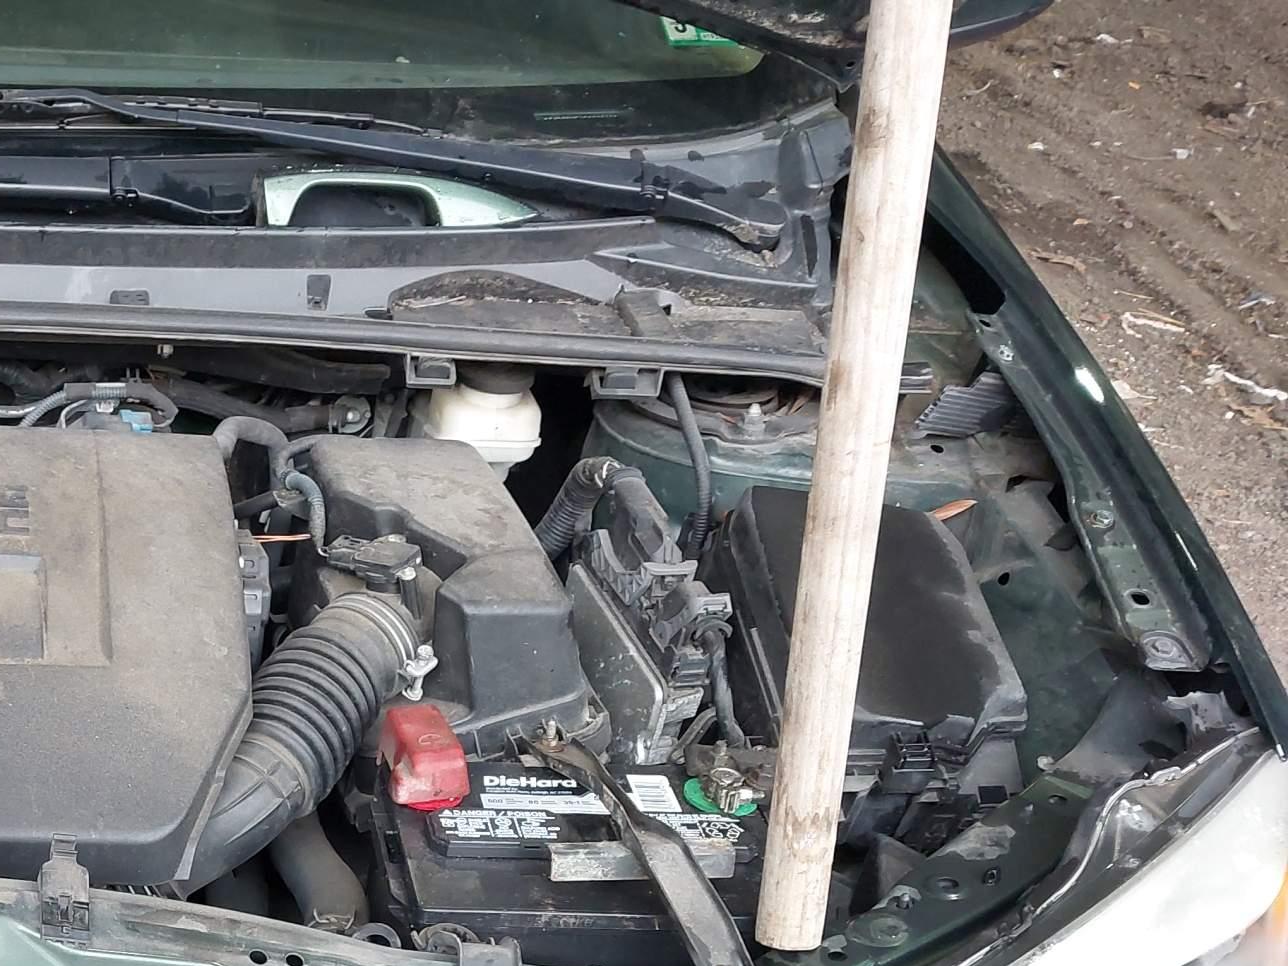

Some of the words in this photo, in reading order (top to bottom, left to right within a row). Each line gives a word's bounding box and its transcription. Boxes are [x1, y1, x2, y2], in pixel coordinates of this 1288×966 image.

[483, 775, 577, 789] DieHard
[453, 809, 497, 817] DANGER
[506, 810, 547, 819] POISON
